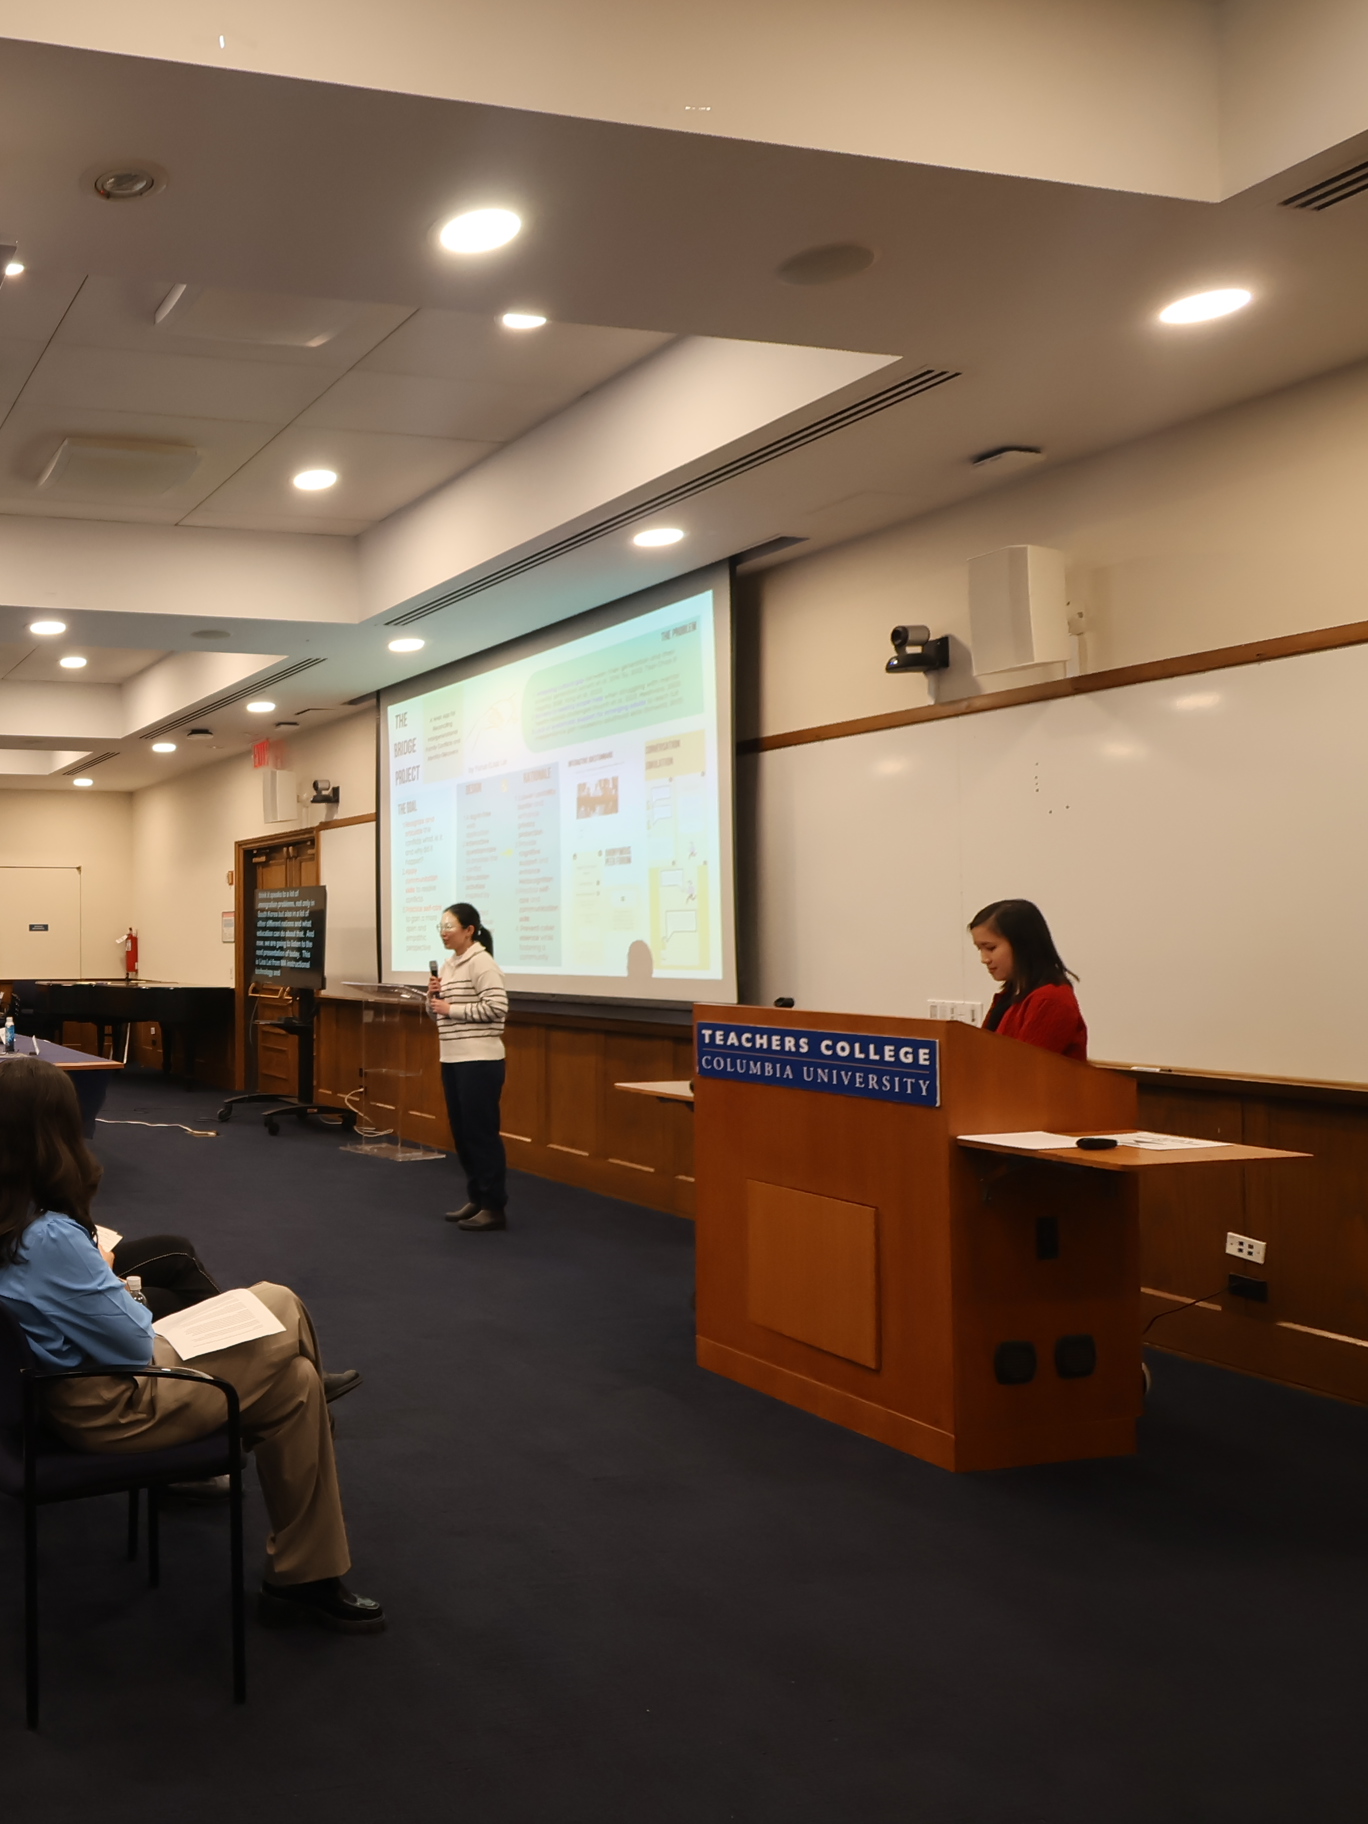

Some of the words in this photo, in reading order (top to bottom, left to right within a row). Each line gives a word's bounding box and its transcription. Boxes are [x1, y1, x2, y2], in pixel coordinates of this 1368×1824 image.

[394, 712, 408, 730] THE
[394, 737, 418, 758] BRIDGE
[395, 764, 420, 786] PROJECT
[523, 767, 552, 784] RATIONALE
[398, 802, 406, 816] THE
[302, 899, 310, 908] only
[266, 920, 281, 928] different
[306, 929, 315, 938] And
[276, 940, 286, 948] going
[263, 949, 285, 958] presentation
[302, 950, 311, 958] This
[287, 960, 311, 968] instructional
[255, 968, 273, 978] technology
[701, 1029, 810, 1053] TEACHERS
[820, 1039, 931, 1066] COLLEGE
[701, 1055, 794, 1080] COLUMBIA
[802, 1066, 931, 1098] UNIVERSITY
